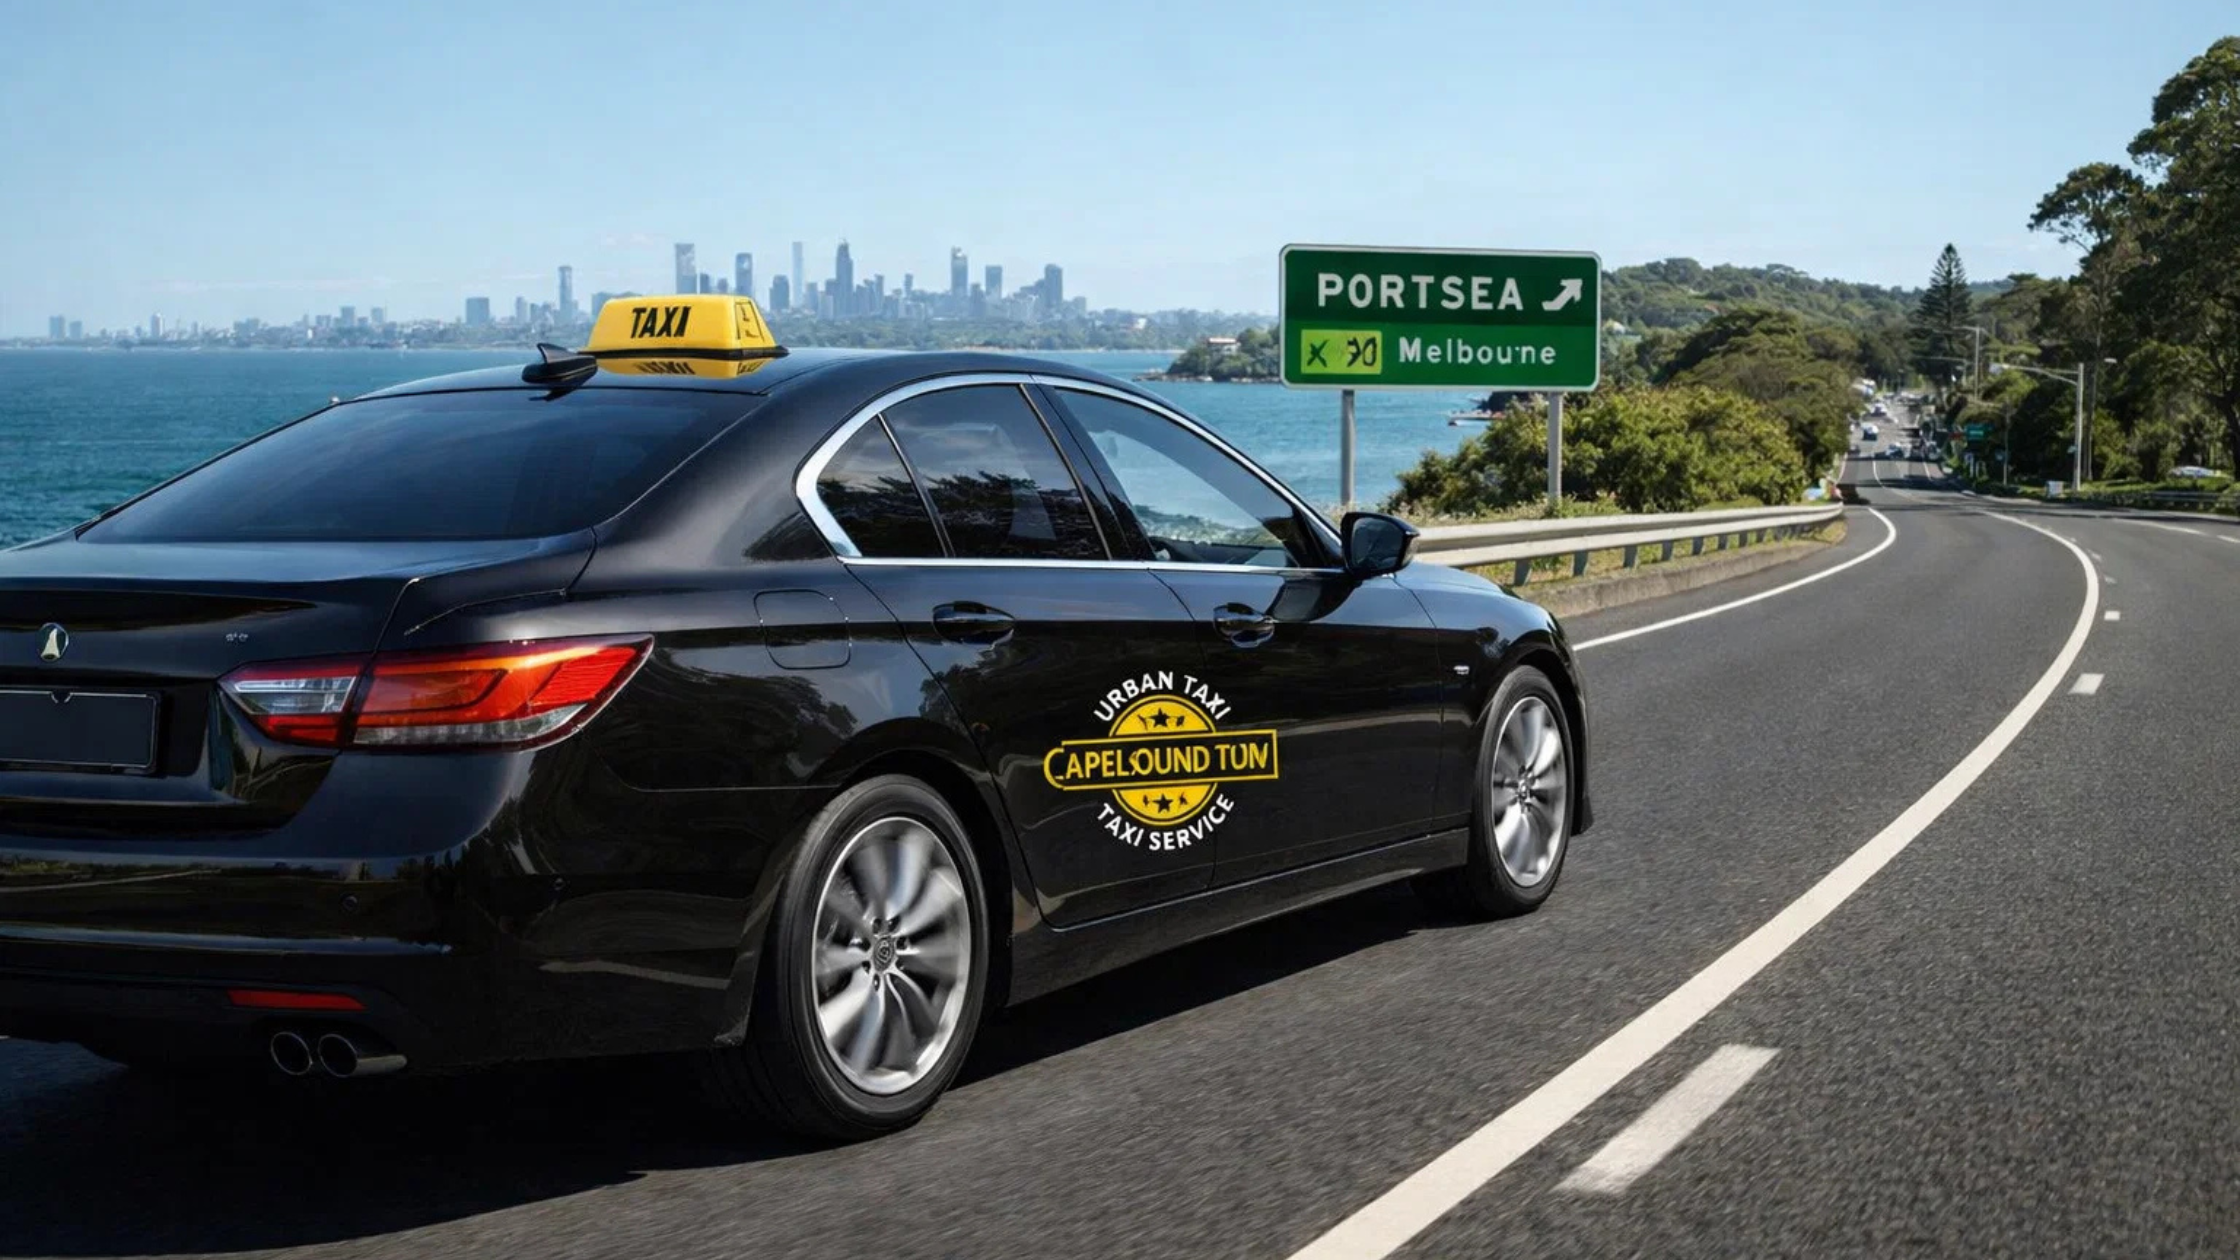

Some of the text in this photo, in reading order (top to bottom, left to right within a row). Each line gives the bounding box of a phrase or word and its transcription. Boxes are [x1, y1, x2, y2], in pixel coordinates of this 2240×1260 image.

[1317, 273, 1524, 311] PORTSEA
[631, 305, 692, 339] TAXI
[1094, 670, 1231, 722] URBAN TAXI
[1097, 794, 1234, 851] TAXI SERVICE
